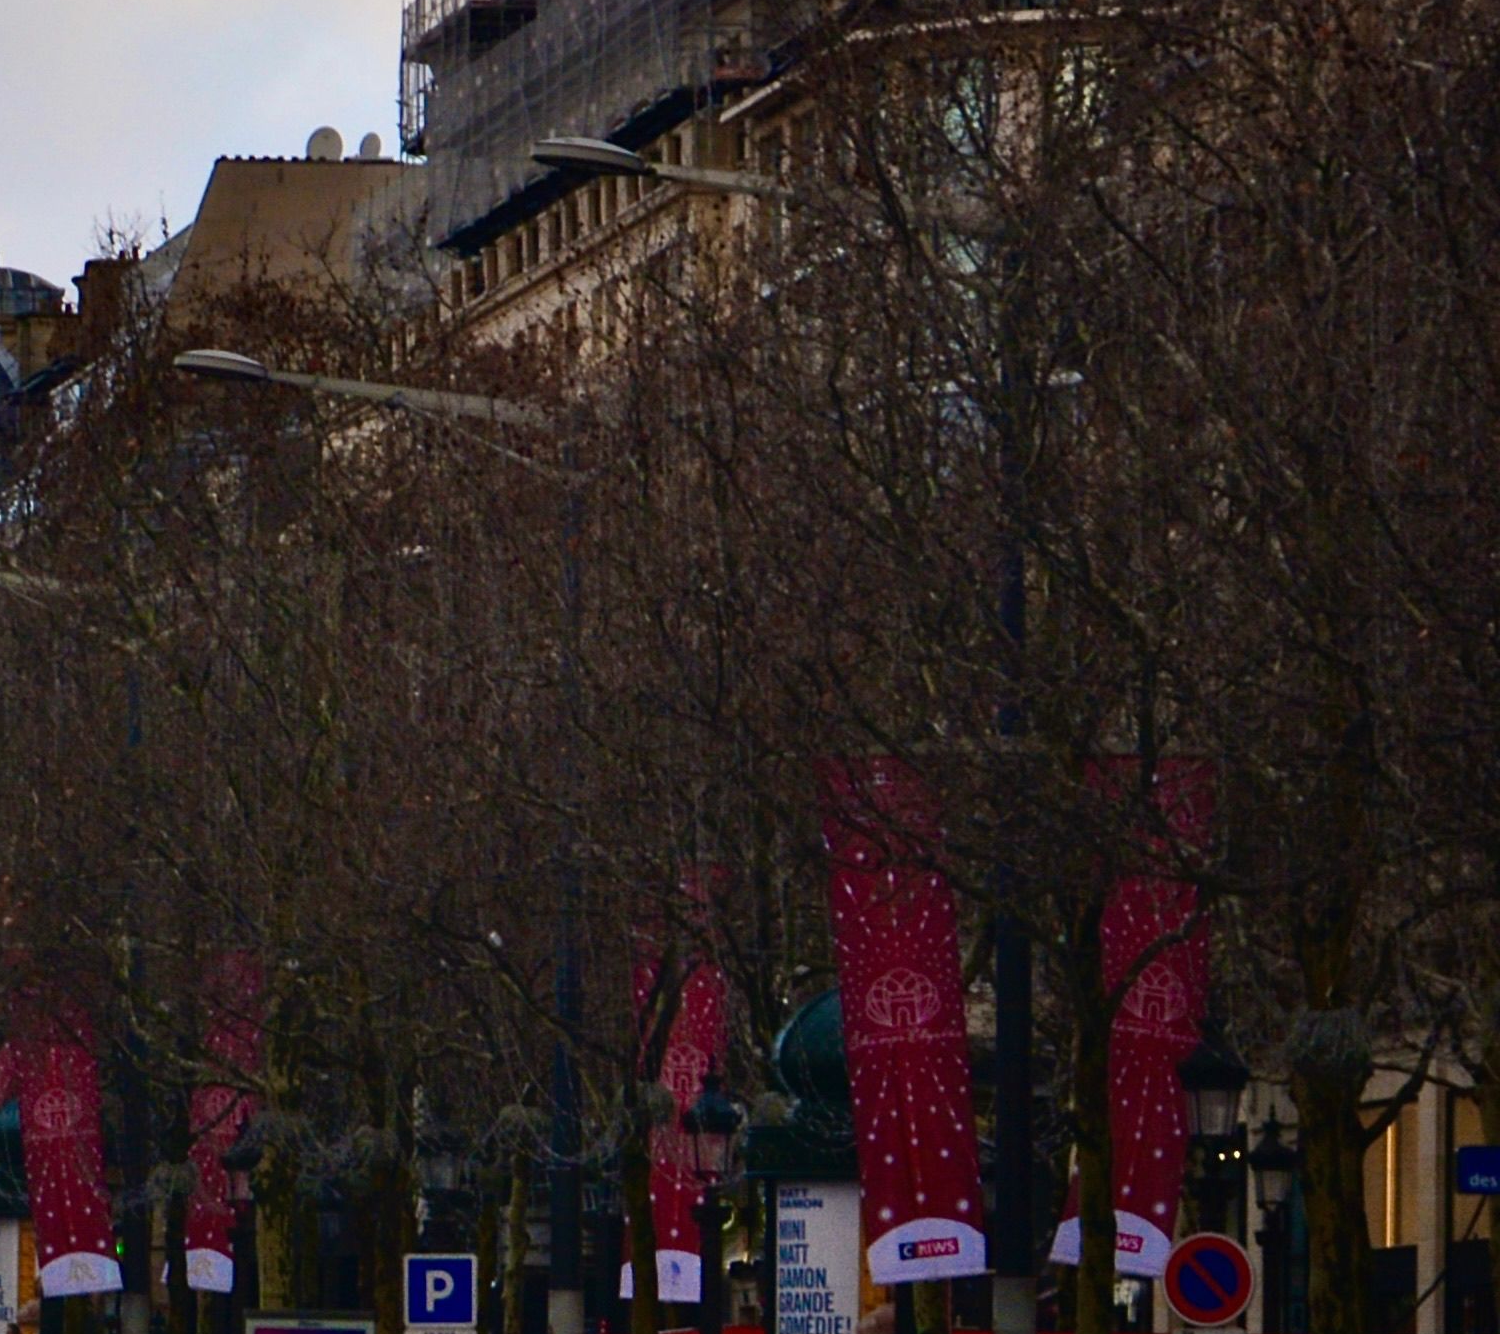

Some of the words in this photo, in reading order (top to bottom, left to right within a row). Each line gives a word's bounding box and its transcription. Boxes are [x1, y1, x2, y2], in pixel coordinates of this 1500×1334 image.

[1469, 1173, 1497, 1188] des
[780, 1219, 806, 1240] MINI
[780, 1244, 809, 1264] MATT
[425, 1269, 455, 1313] P
[780, 1291, 835, 1313] GRANDE
